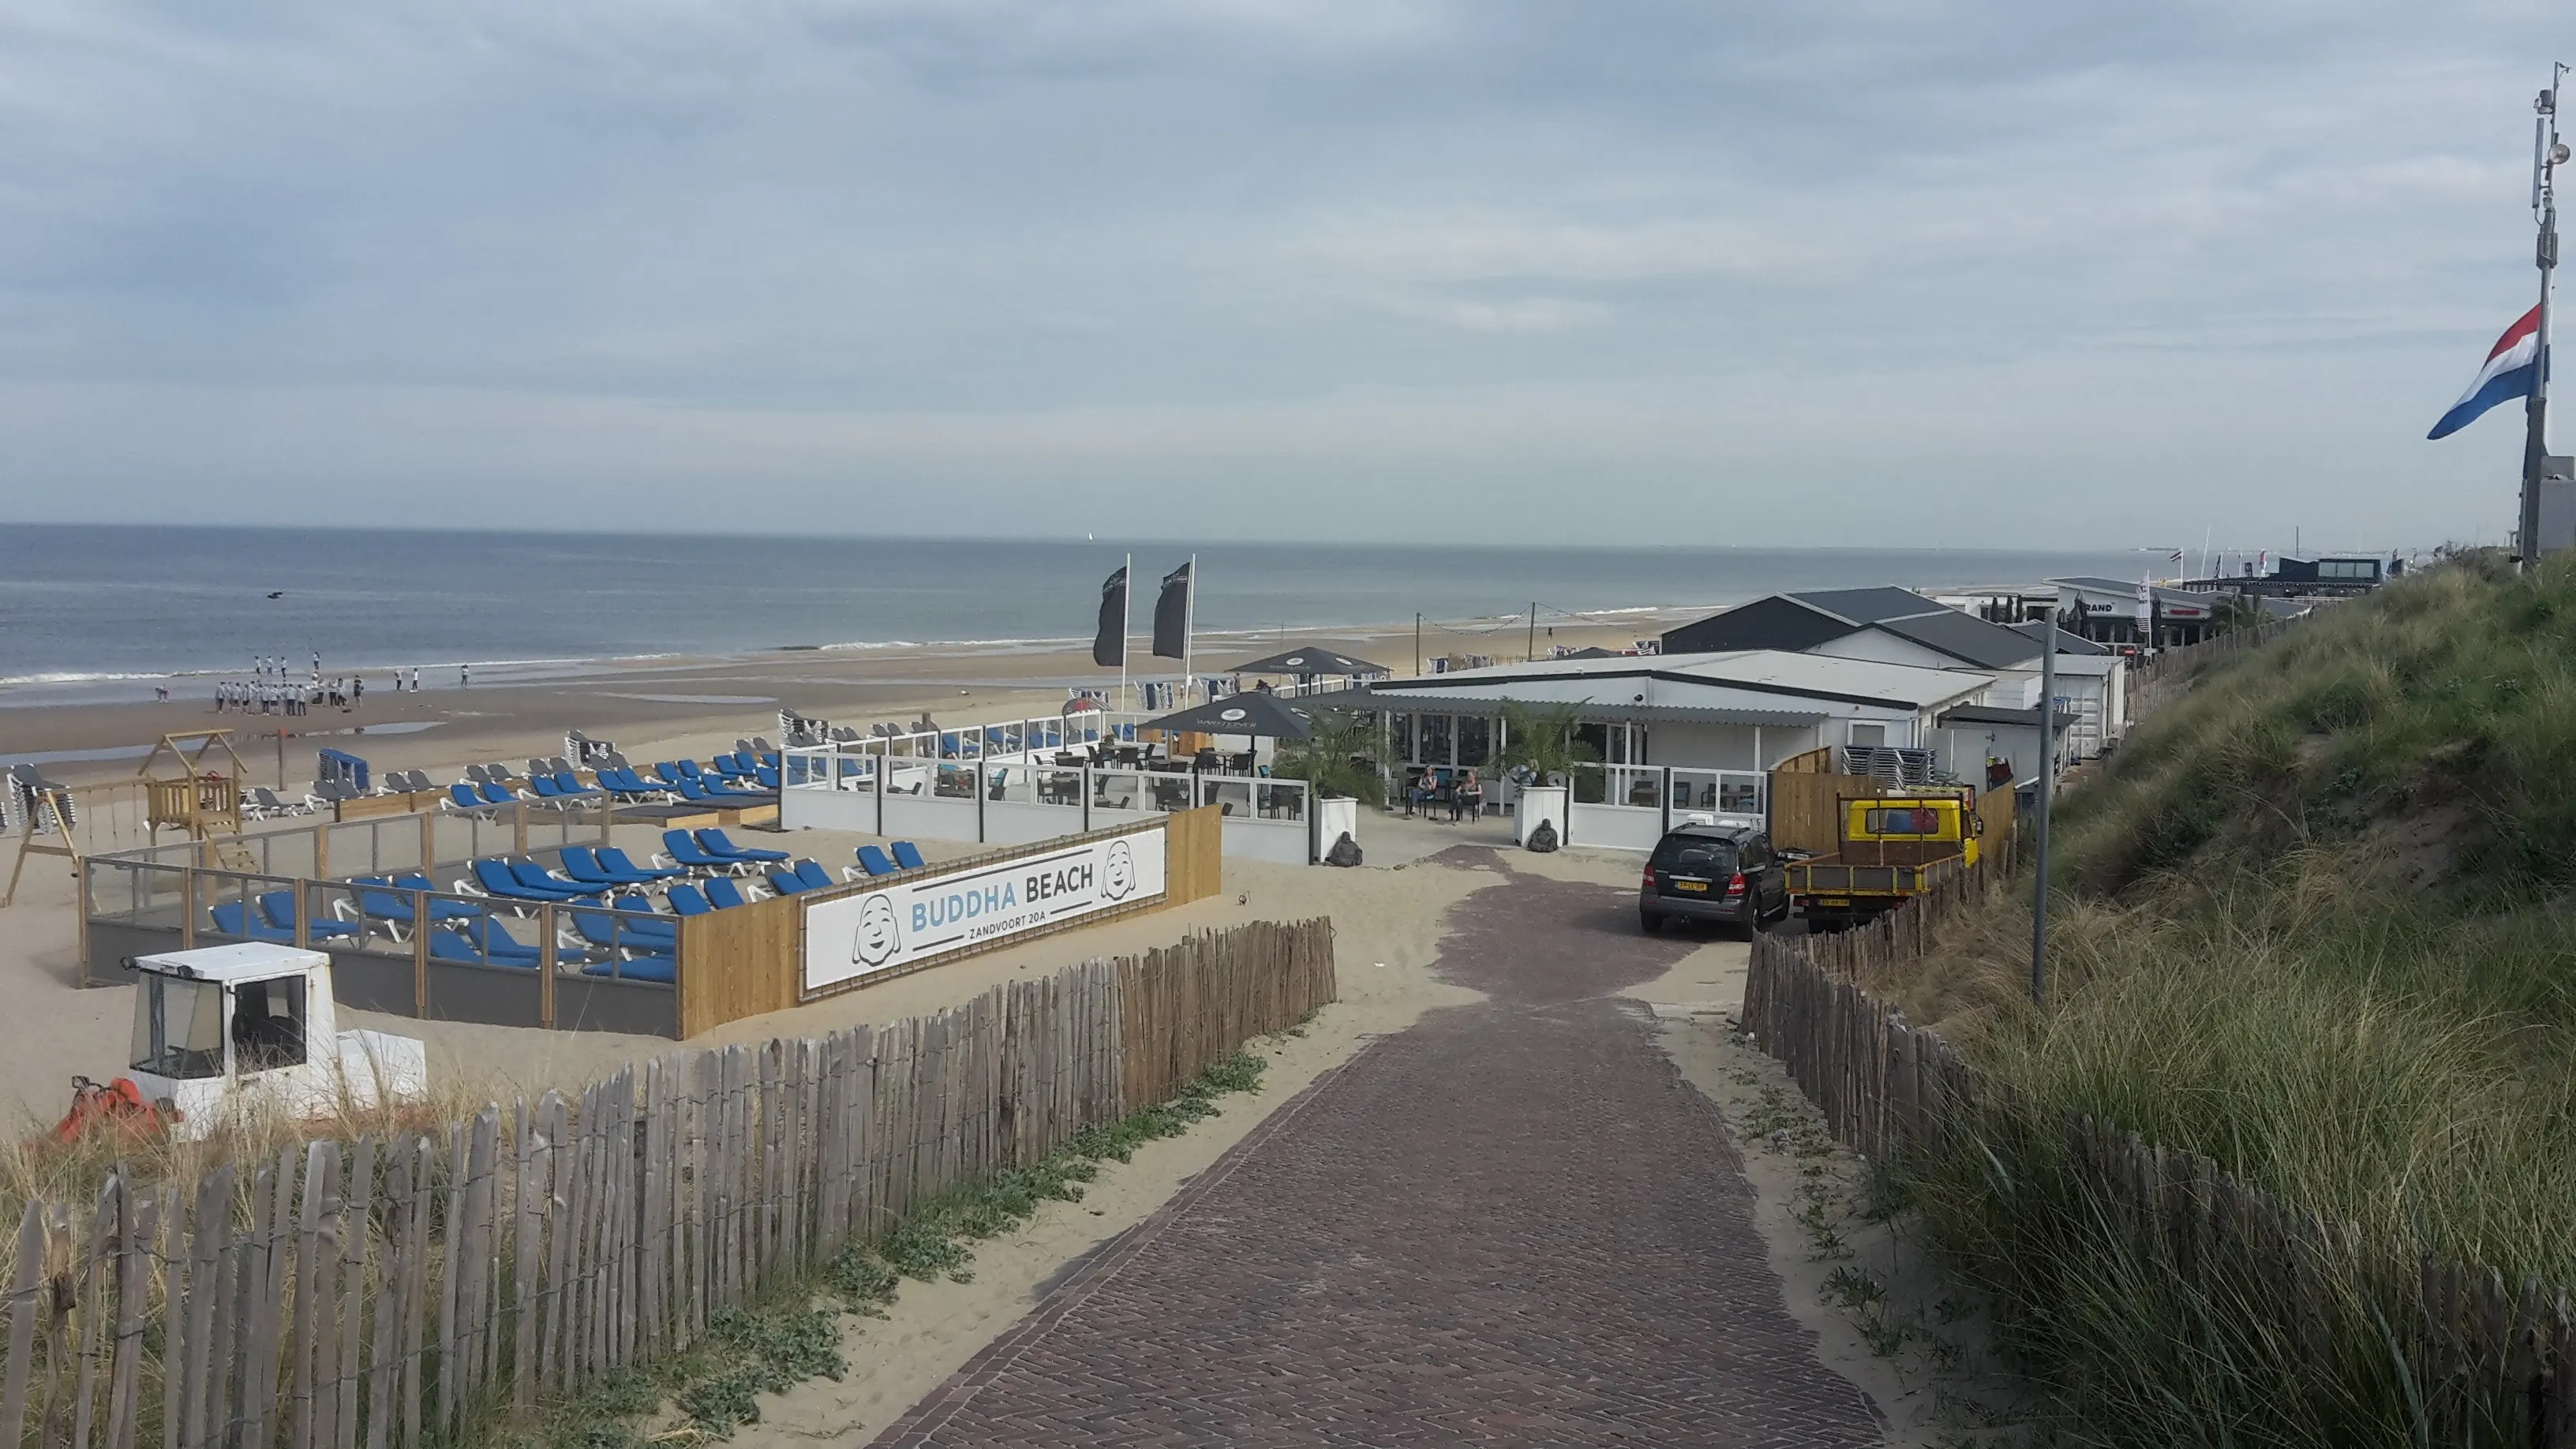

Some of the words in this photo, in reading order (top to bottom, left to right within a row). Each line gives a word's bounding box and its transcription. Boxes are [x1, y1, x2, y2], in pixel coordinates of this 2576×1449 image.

[912, 882, 1017, 932] BUDDHA
[1026, 863, 1093, 904] BEACH
[969, 915, 1027, 940] ZANDVOORT
[1028, 911, 1046, 924] 20A
